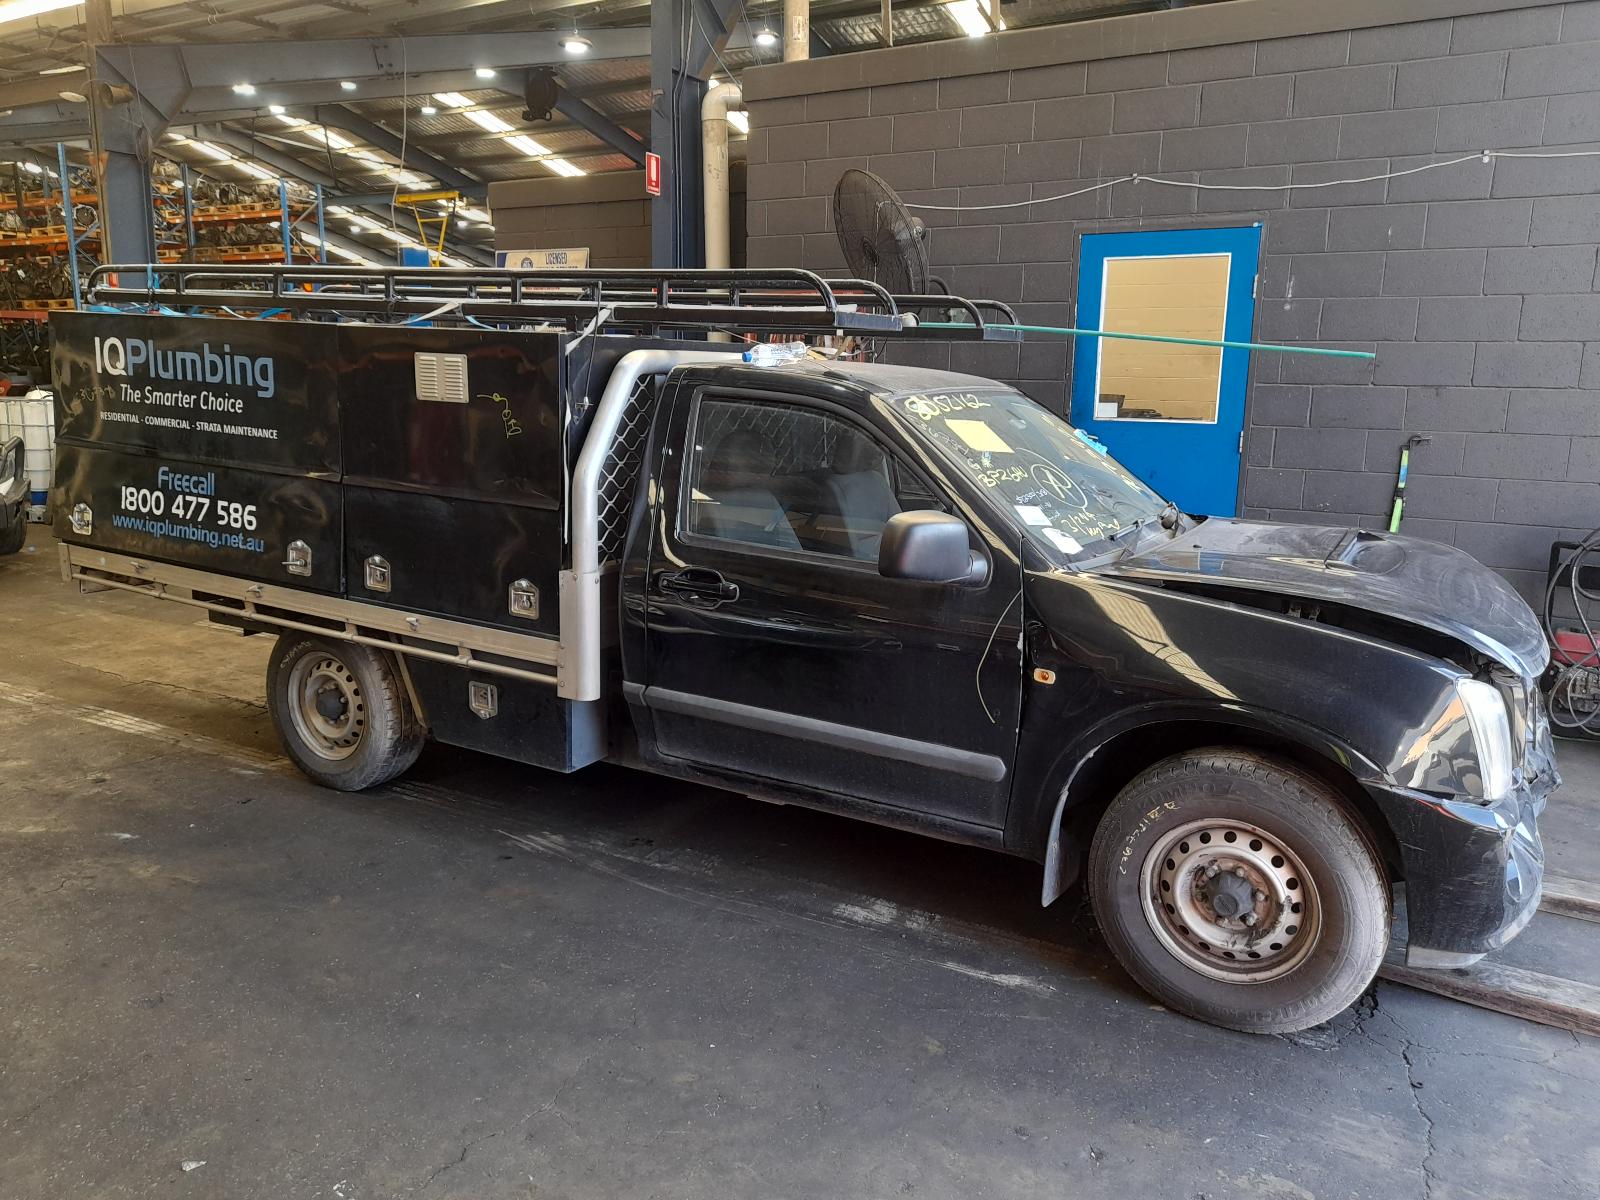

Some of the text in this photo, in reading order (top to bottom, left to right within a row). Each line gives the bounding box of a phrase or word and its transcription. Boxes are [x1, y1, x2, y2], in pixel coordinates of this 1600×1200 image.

[119, 383, 142, 404] The
[144, 386, 197, 409] Smarter
[200, 390, 244, 413] Choice
[100, 411, 140, 424] RESIDENTIAL
[144, 415, 190, 430] COMMERCIAL
[196, 420, 222, 433] STRATA
[223, 424, 278, 440] MAINTENANCE
[121, 485, 257, 531] 1800 477 586
[112, 512, 265, 553] www.iqplumbing.net.au
